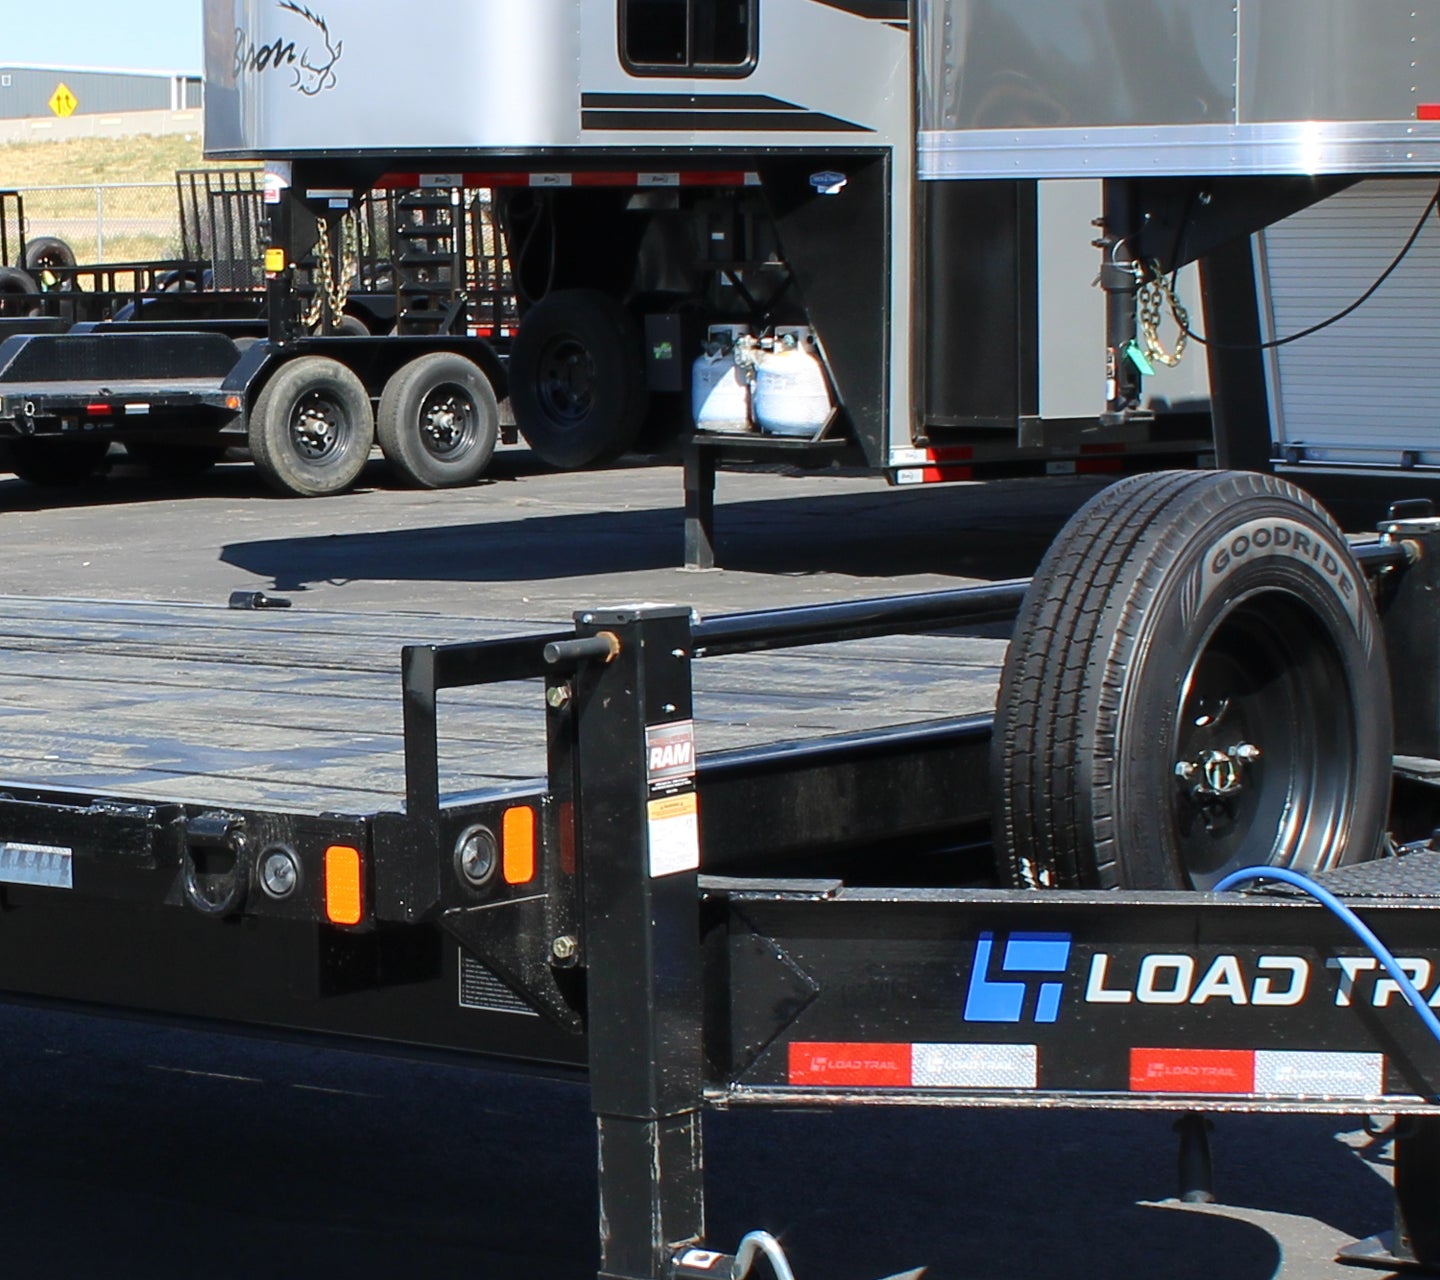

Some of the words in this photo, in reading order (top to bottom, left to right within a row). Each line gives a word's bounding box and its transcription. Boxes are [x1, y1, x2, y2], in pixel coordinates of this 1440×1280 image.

[1211, 526, 1354, 600] GOODRIDE
[650, 742, 691, 771] RAM
[1084, 953, 1309, 1006] LOAD
[828, 1060, 860, 1070] LOAD
[861, 1060, 898, 1070] TRAIL
[945, 1060, 977, 1070] LOAD
[979, 1061, 1017, 1071] TRAIL
[1165, 1066, 1200, 1076] LOAD
[1201, 1066, 1238, 1077] TRAIL
